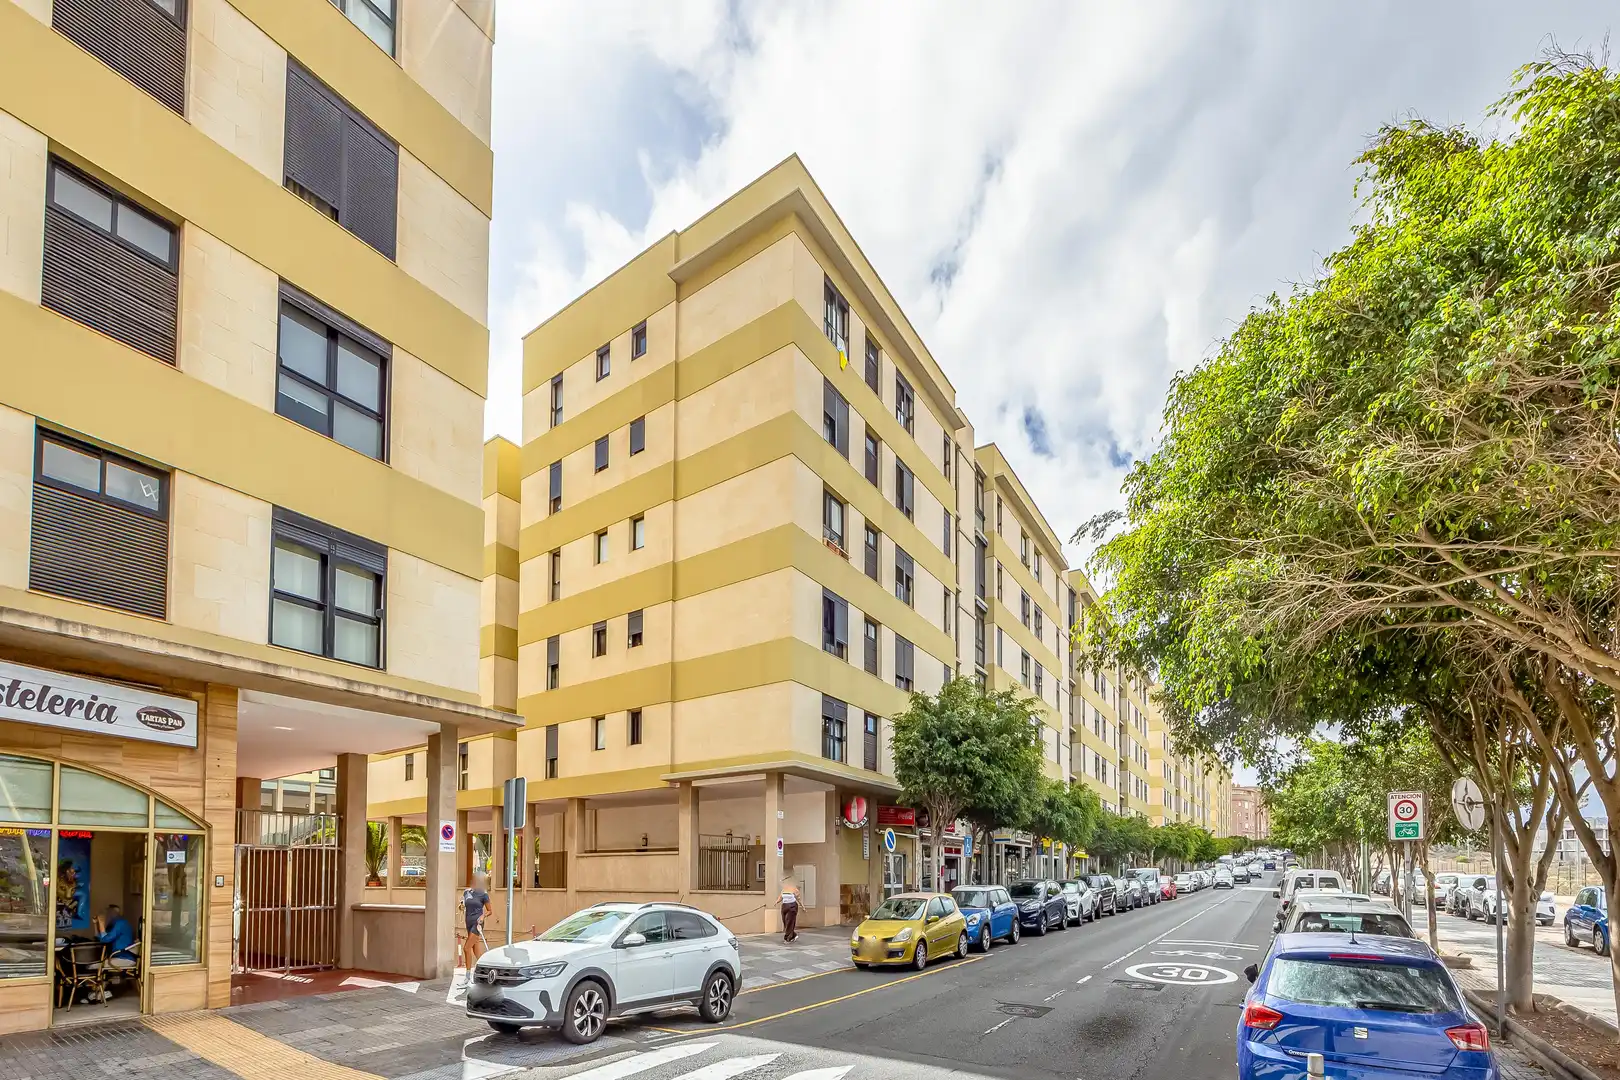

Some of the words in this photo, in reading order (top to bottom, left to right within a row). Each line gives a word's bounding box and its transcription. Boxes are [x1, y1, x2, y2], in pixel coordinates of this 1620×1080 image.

[140, 713, 167, 724] TARTAS
[168, 717, 183, 727] PAN
[1152, 966, 1210, 981] 30
